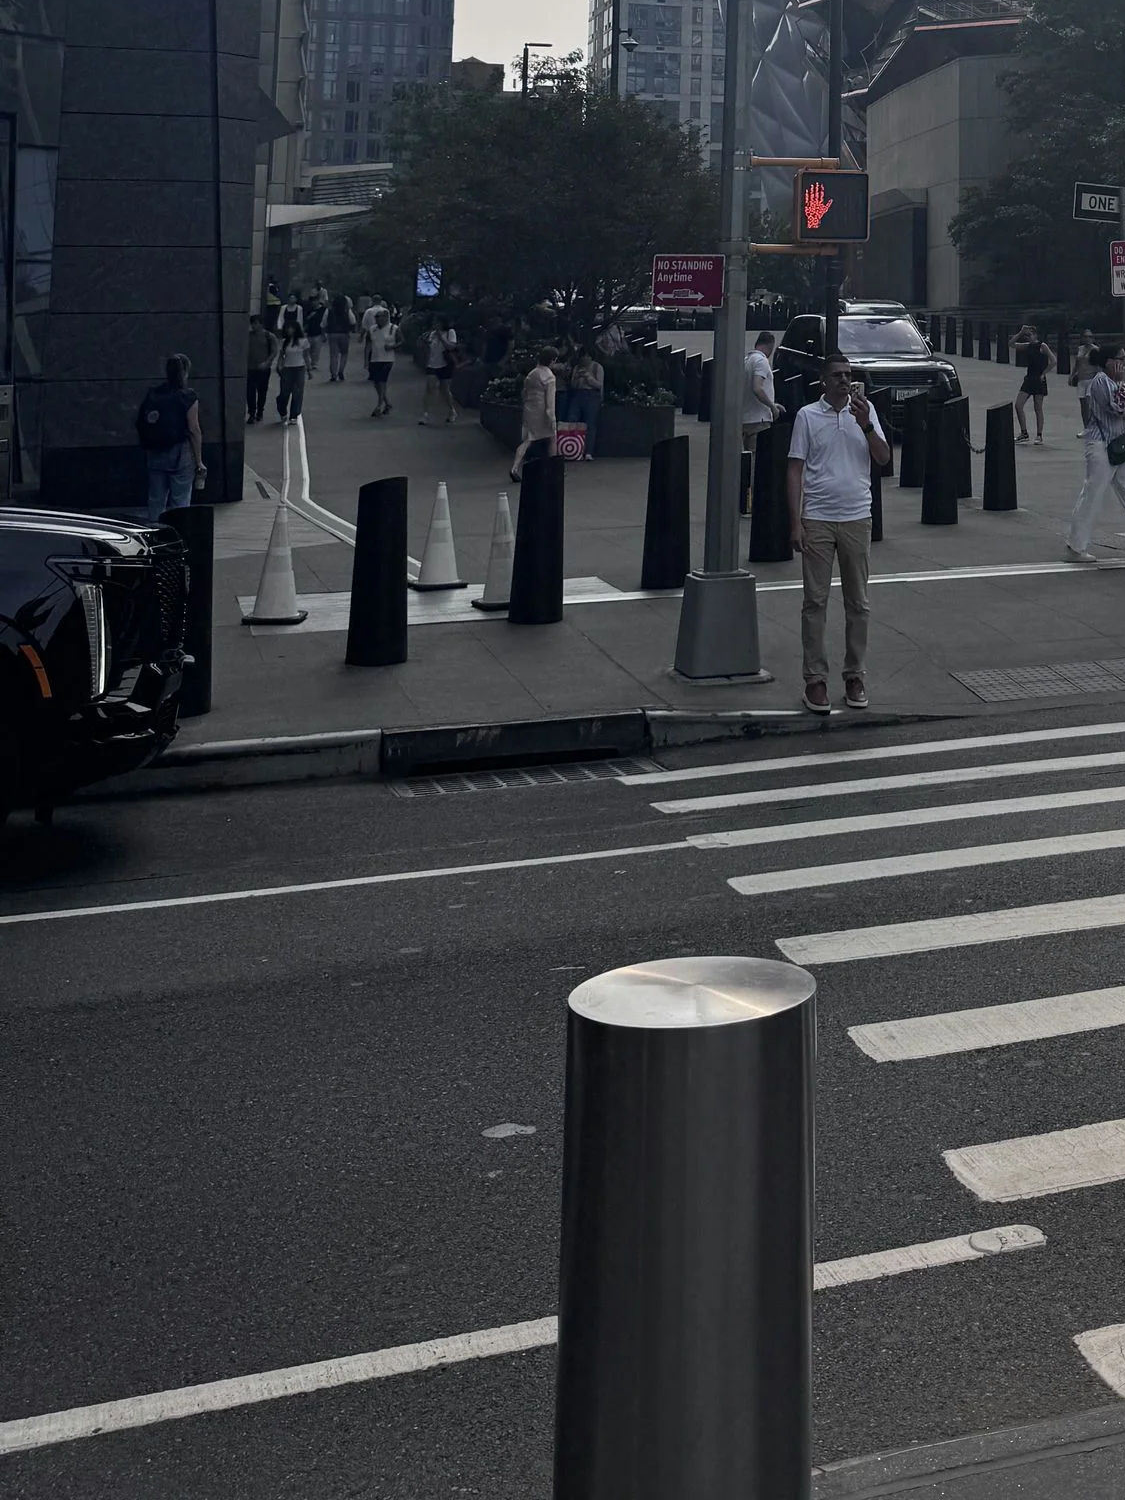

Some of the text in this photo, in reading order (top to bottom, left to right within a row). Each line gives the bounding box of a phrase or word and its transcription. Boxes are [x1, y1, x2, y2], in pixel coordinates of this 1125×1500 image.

[1088, 195, 1115, 211] ONE
[1114, 246, 1123, 254] DO
[657, 260, 713, 271] NO STANDING
[657, 272, 693, 284] Anytime
